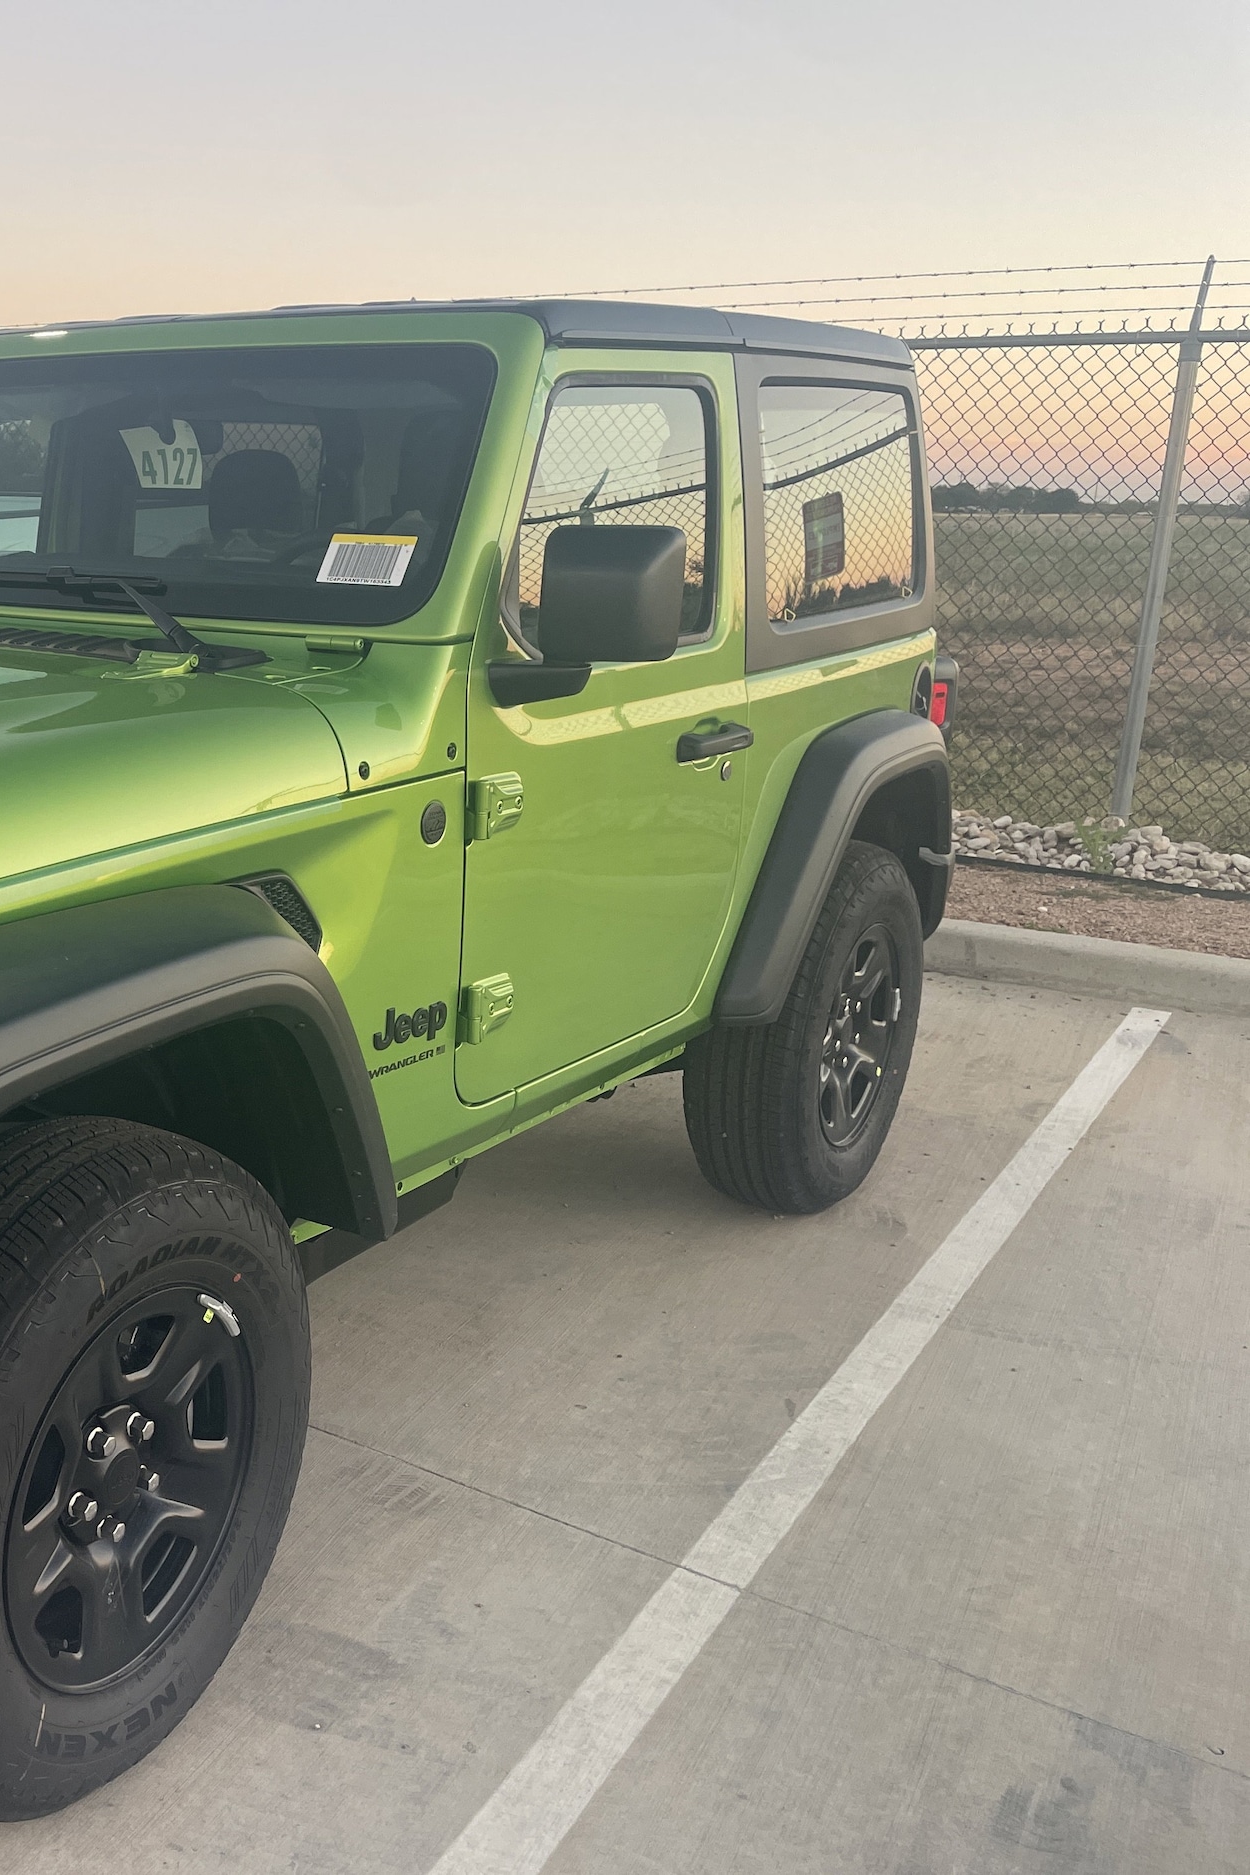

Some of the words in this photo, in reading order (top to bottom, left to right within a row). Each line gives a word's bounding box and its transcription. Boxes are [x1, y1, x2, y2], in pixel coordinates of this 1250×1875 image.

[141, 447, 198, 486] 4127
[372, 1001, 448, 1051] Jeep
[368, 1049, 434, 1080] WRANGLER
[86, 1236, 223, 1327] ROADIAN
[35, 1678, 178, 1758] NEXEN
